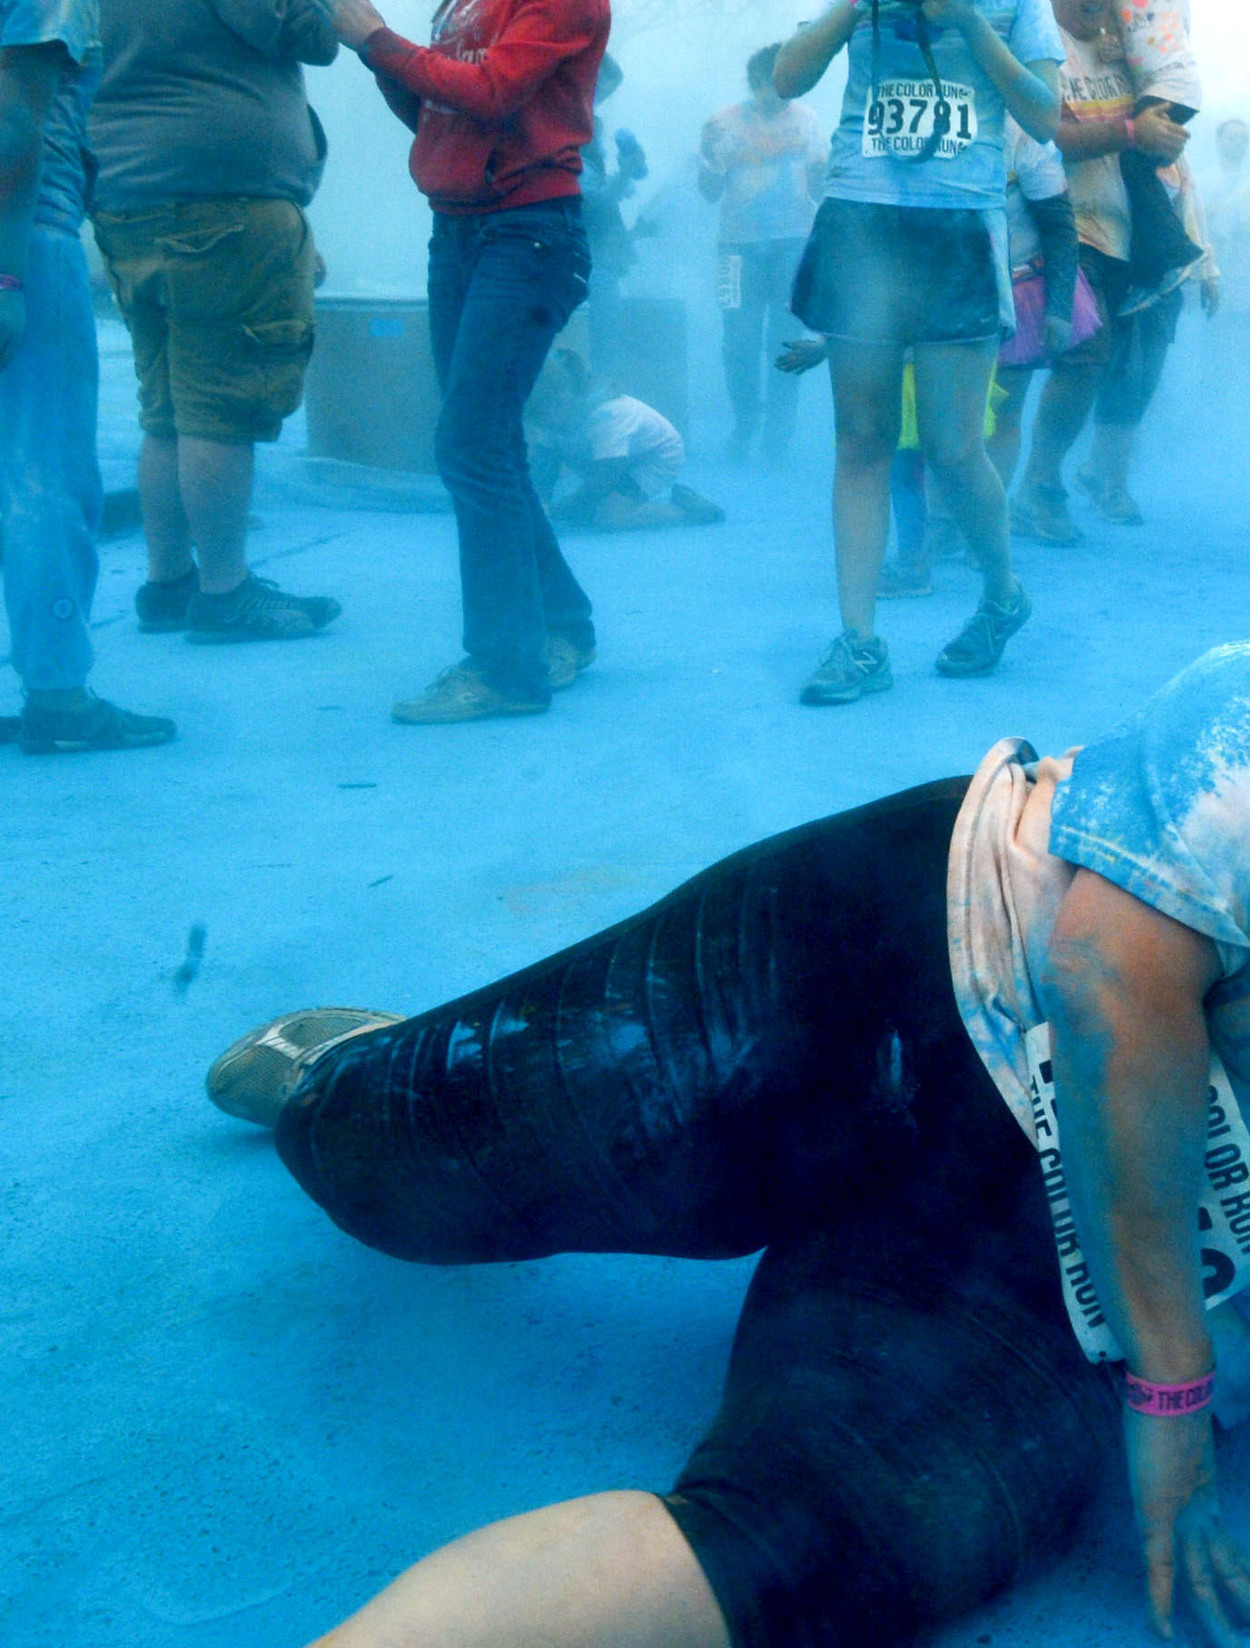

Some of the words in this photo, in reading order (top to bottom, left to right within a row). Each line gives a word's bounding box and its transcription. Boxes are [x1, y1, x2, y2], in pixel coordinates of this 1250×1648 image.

[896, 83, 933, 97] COLOR
[867, 98, 972, 140] 93781
[893, 137, 928, 151] COLO
